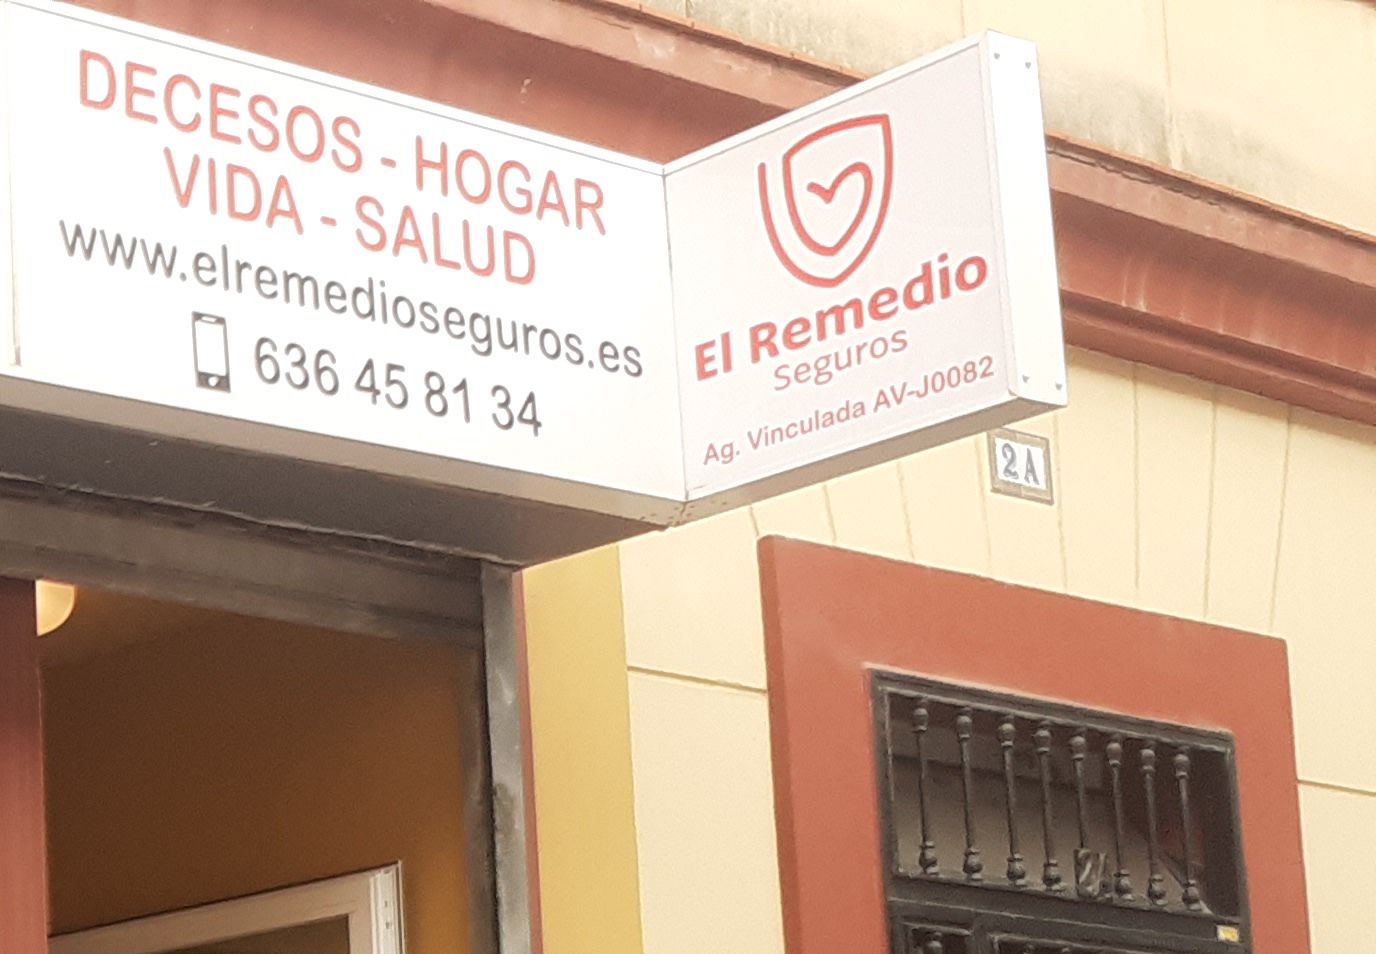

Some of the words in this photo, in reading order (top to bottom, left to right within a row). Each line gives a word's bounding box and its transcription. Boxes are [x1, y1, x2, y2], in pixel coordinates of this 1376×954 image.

[79, 49, 363, 174] DECESOS
[415, 136, 605, 235] HOGAR
[164, 147, 303, 234] VIDA
[355, 195, 536, 286] SALUD
[59, 220, 643, 378] www.elremedioseguros.es
[694, 332, 734, 382] El
[749, 253, 989, 364] Remedio
[773, 329, 909, 391] Seguros
[255, 337, 340, 396] 636
[355, 358, 409, 409] 45
[424, 371, 471, 424] 81
[491, 384, 543, 437] 34
[703, 442, 741, 466] Ag.
[747, 400, 867, 450] Vinculada
[873, 355, 995, 413] AV-J0082
